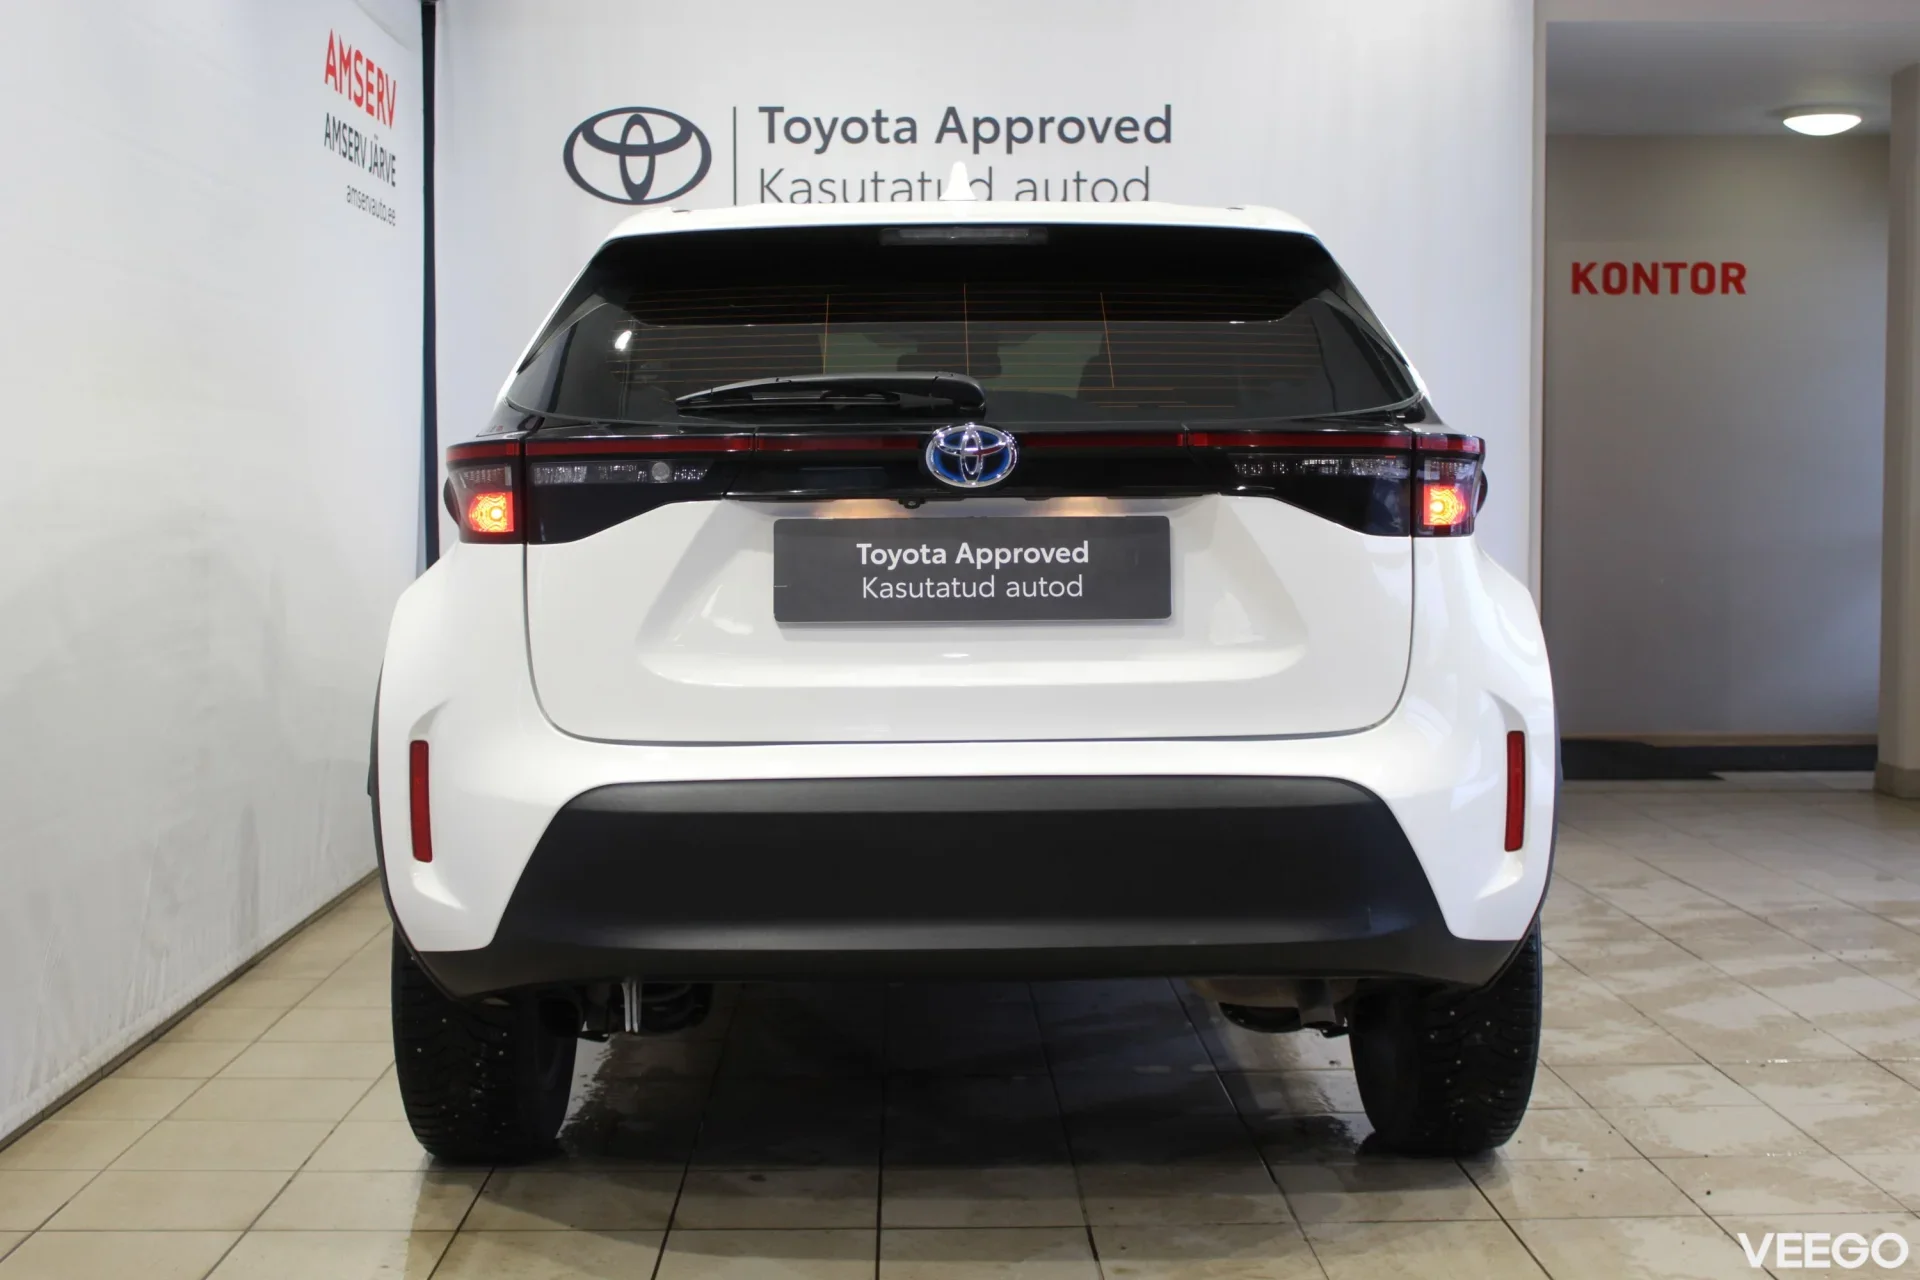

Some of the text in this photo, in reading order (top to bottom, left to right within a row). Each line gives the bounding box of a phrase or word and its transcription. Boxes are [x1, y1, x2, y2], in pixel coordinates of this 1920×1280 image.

[324, 27, 397, 130] AMSERV
[758, 103, 1173, 155] Toyota Approved
[323, 112, 396, 187] AMSERV JÄRVE
[1014, 165, 1150, 201] autod
[346, 184, 396, 226] amservauto.ee
[1571, 261, 1747, 296] KONTOR
[856, 540, 1089, 571] Toyota Approved
[862, 574, 1083, 599] Kasutatud autod
